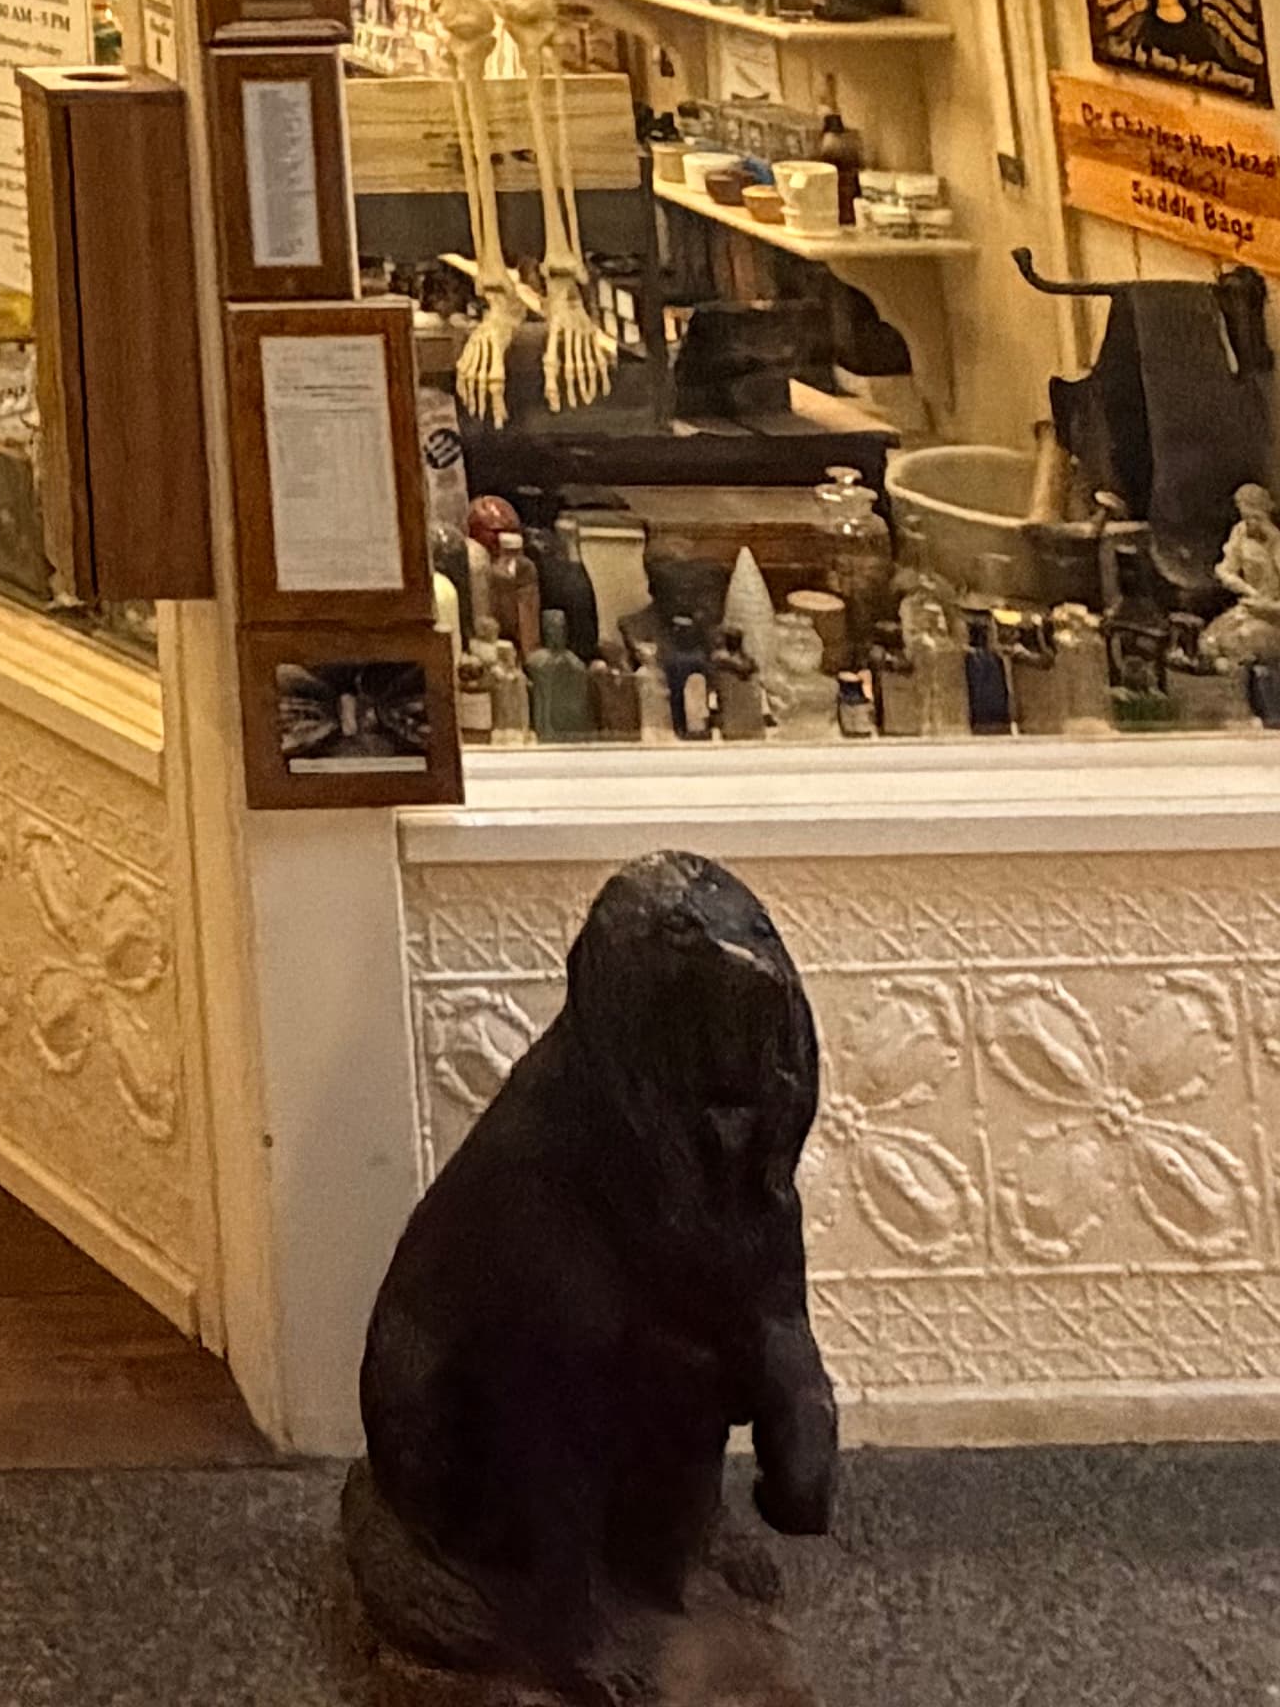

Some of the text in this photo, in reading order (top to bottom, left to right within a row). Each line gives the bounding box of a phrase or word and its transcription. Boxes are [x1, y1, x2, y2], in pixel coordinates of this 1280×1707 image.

[12, 5, 32, 24] AM
[51, 13, 71, 33] PM
[1109, 110, 1185, 153] Charles
[1131, 179, 1256, 253] Saddle Bags
